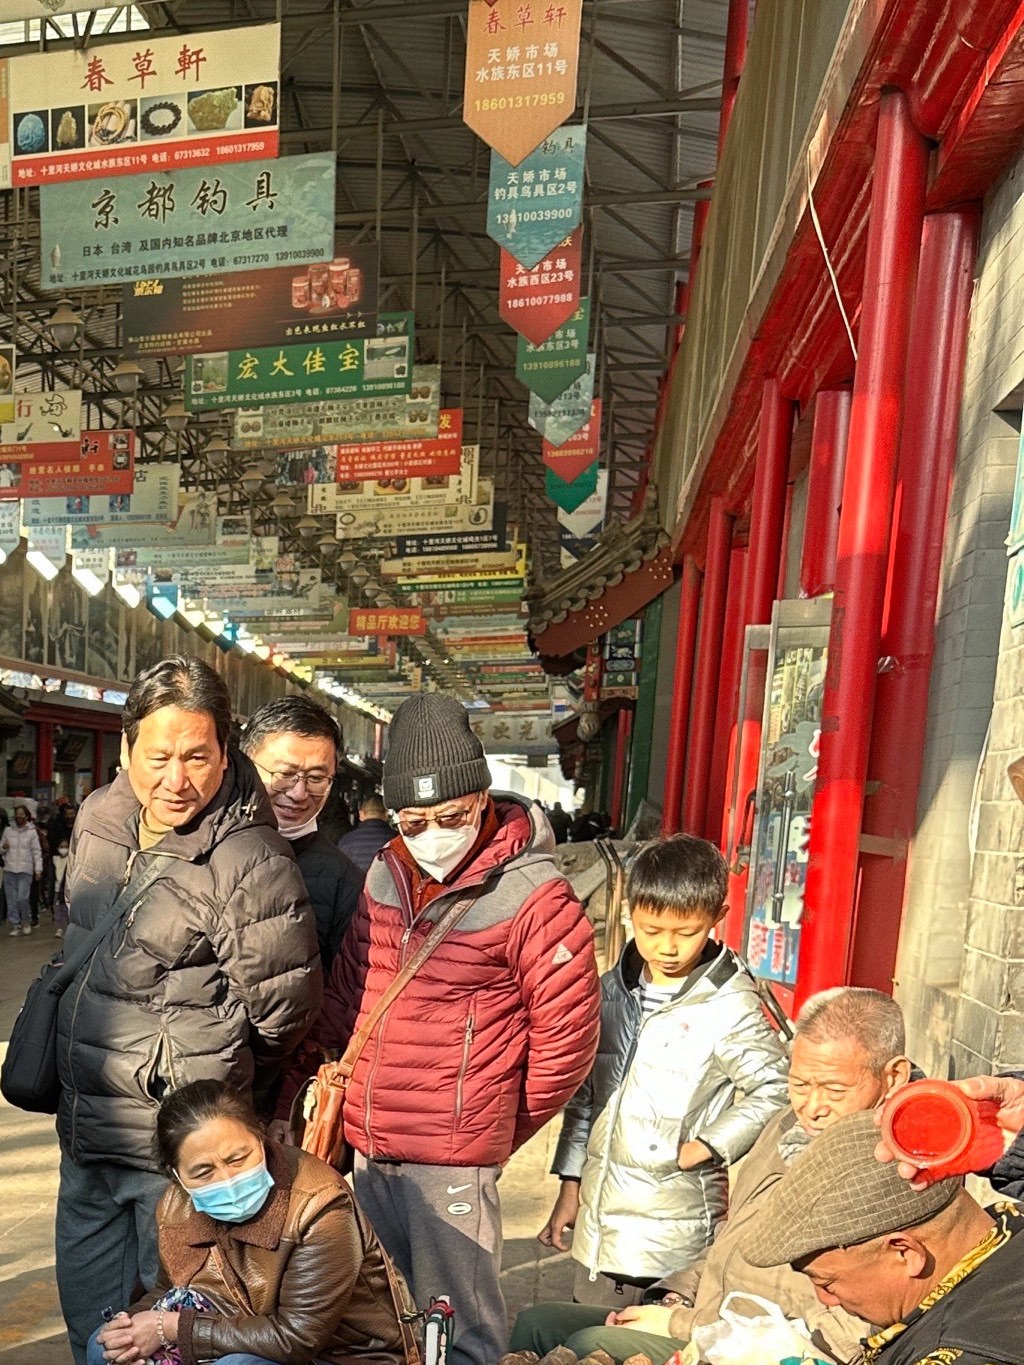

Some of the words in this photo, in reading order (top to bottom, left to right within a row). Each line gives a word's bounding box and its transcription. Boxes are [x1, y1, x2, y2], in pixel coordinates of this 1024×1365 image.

[483, 4, 568, 34] 春草轩
[488, 42, 559, 64] 天娇市场
[476, 60, 568, 83] 水族东区11号
[475, 92, 565, 112] 18601317959
[40, 154, 148, 177] 十里河天娇文化城水族东区11号
[507, 167, 567, 185] 天娇市场
[91, 171, 278, 230] 京都钓具
[494, 181, 577, 200] 钓具鸟具区2号
[83, 244, 104, 257] 日本
[110, 242, 132, 255] 台湾
[139, 225, 288, 252] 及国内知名品牌北京地区代理
[236, 342, 360, 381] 宏大佳宝
[356, 614, 421, 630] 精品厅欢迎您
